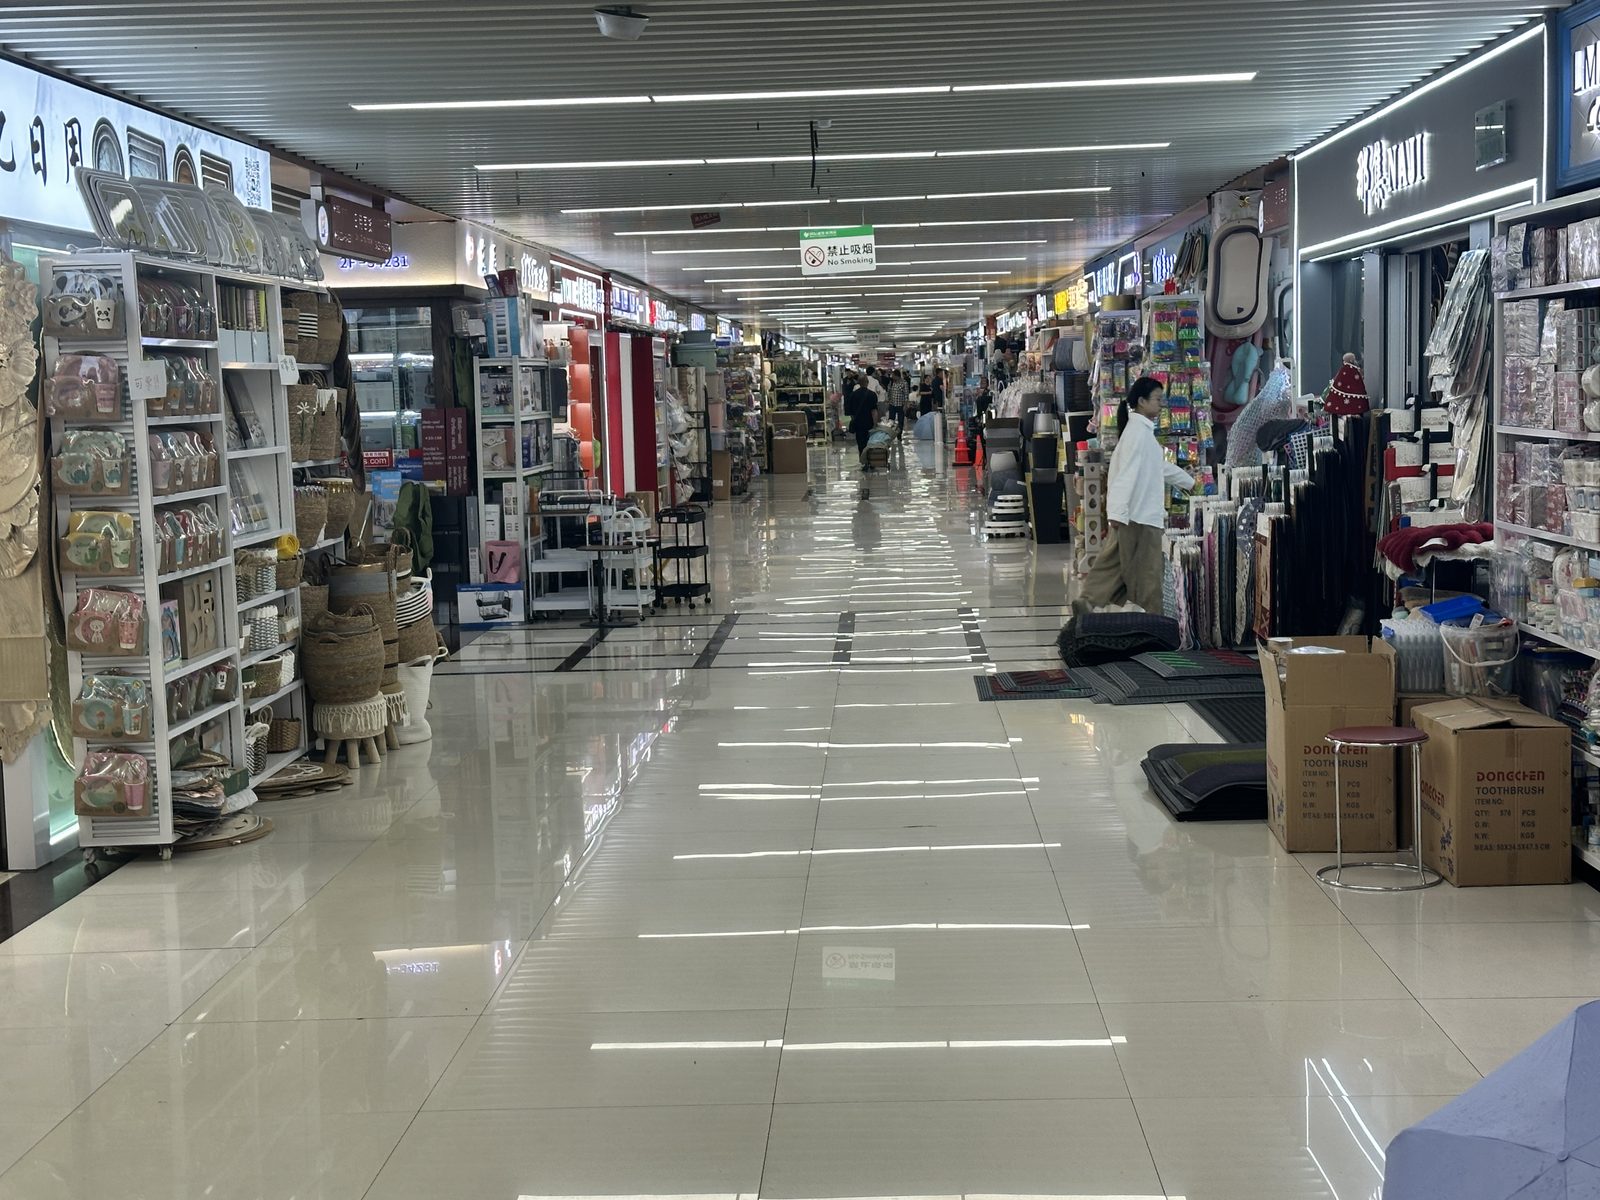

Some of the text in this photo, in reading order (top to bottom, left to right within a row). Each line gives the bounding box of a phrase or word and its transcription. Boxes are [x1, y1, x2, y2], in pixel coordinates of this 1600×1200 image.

[827, 243, 873, 257] 禁止吸烟
[840, 256, 874, 265] Smoking
[1475, 786, 1545, 795] TOOTHBRUSH
